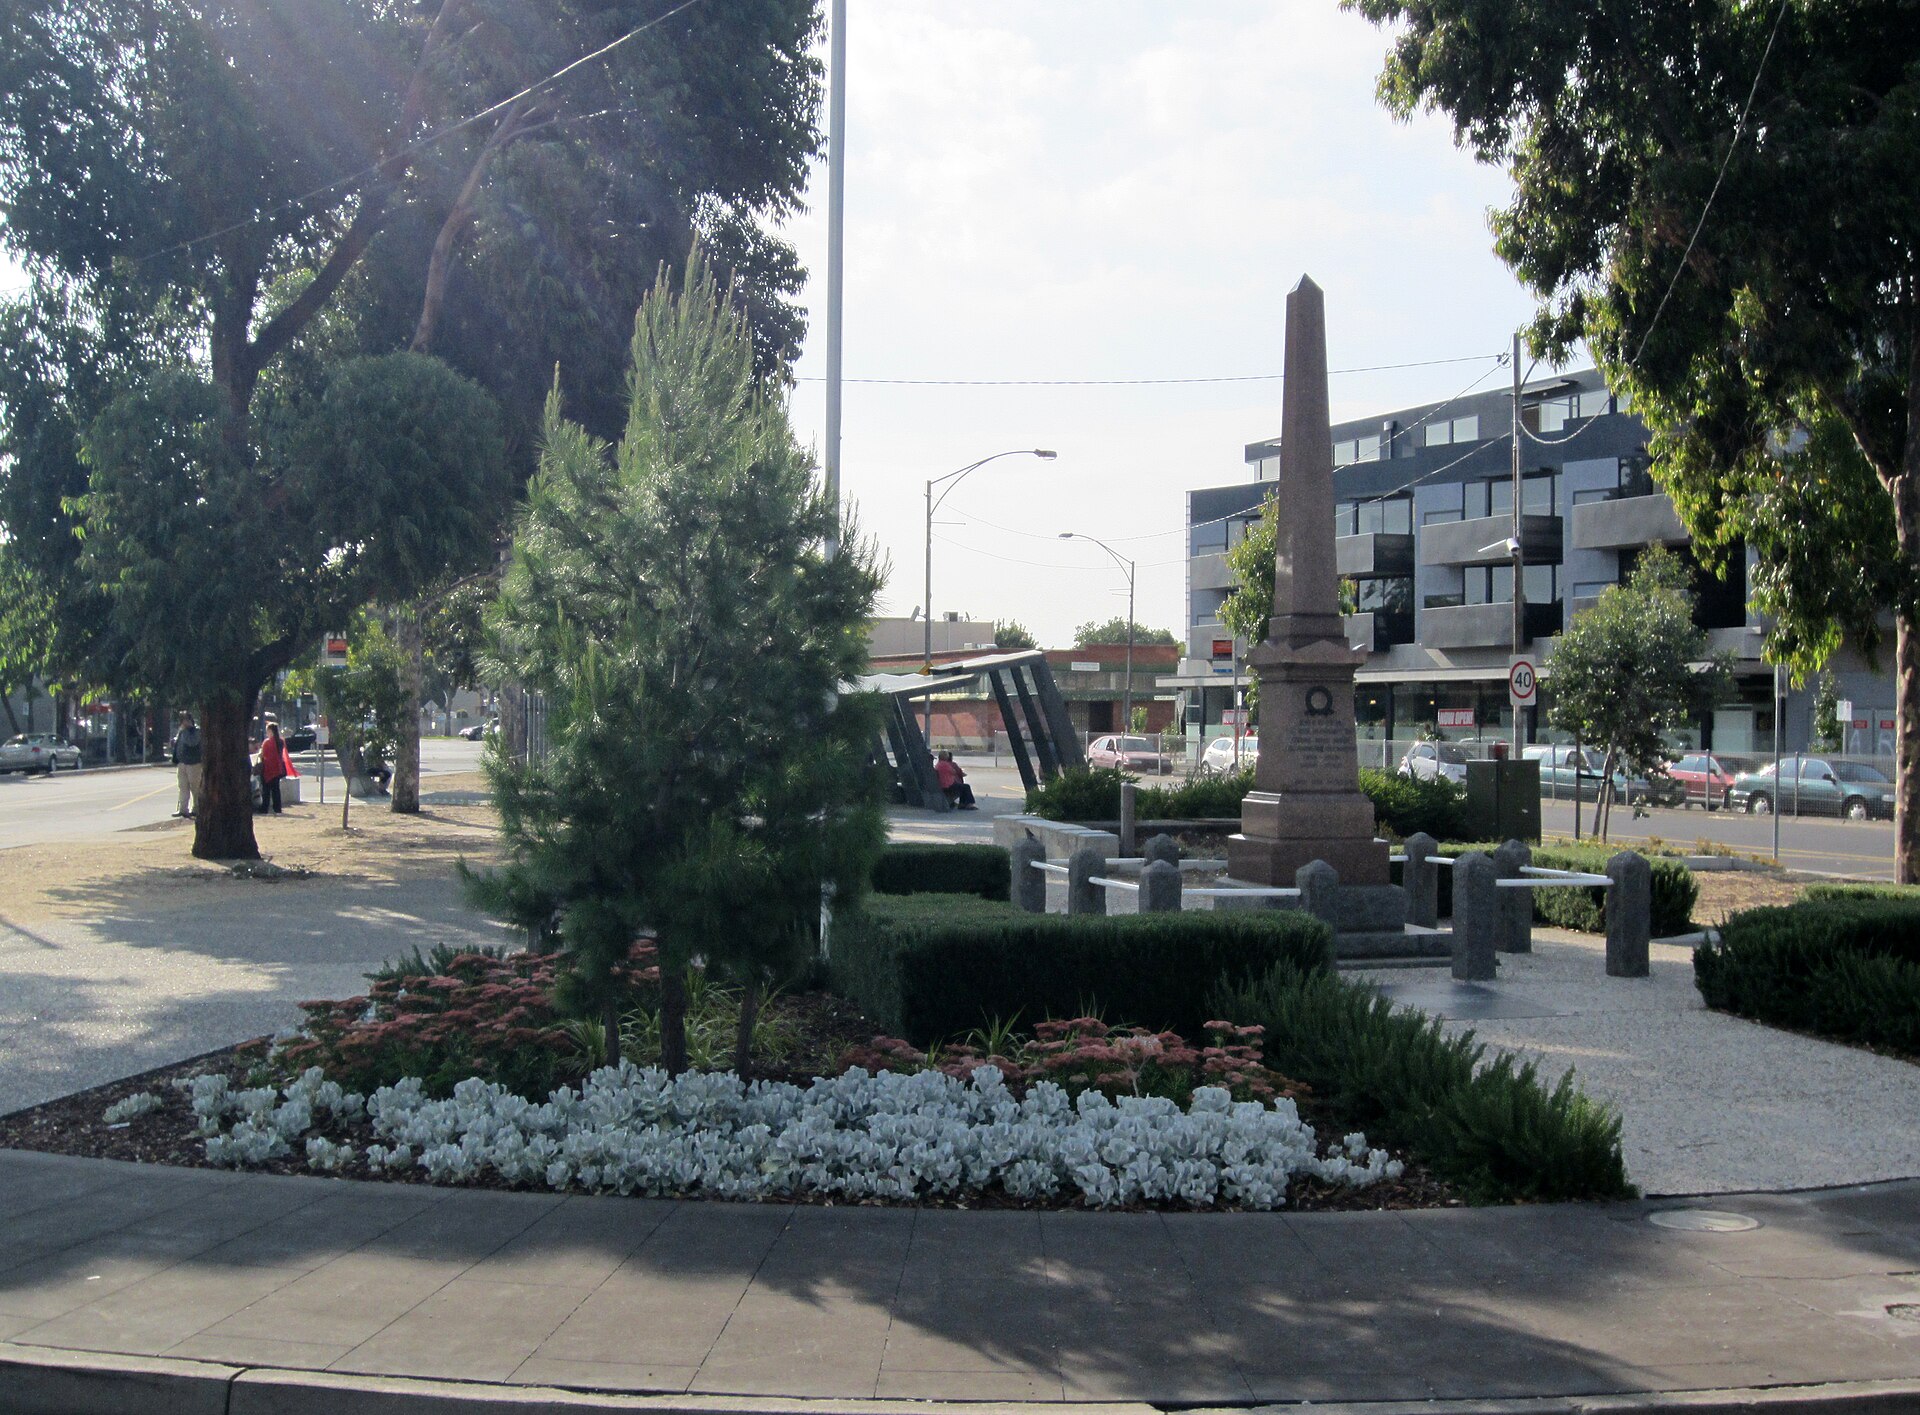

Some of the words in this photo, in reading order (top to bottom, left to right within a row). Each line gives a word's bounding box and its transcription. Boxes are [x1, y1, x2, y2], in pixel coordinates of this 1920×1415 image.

[1515, 672, 1531, 688] 40
[1439, 712, 1454, 725] NOW
[1455, 711, 1473, 725] OPEN
